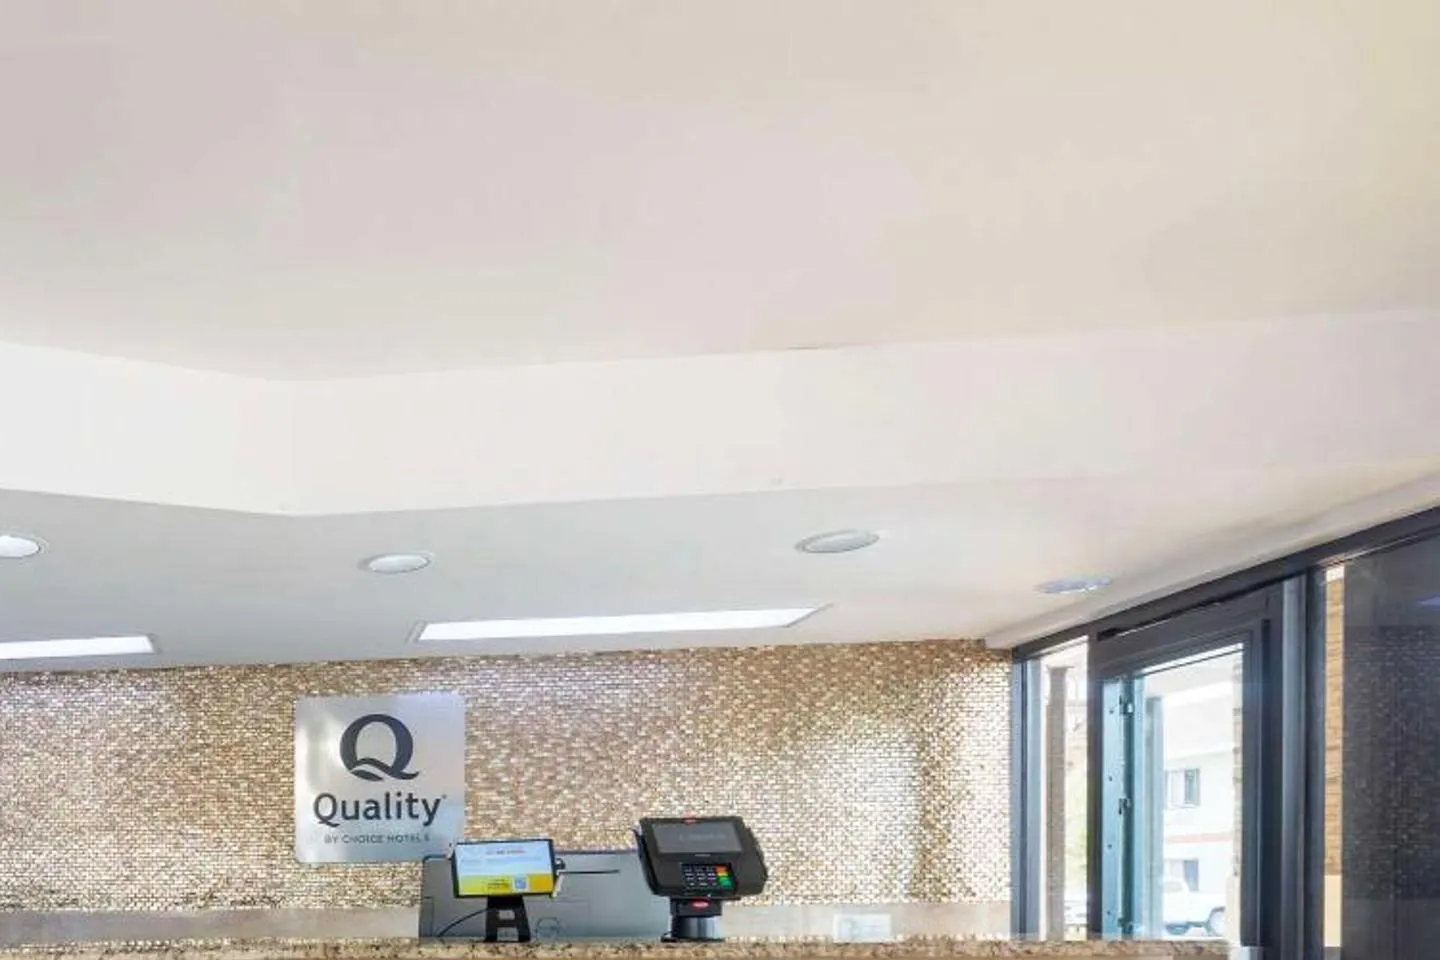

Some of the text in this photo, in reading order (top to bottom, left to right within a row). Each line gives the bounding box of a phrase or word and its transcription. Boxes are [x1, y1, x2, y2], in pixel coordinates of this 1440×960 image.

[340, 713, 420, 782] Q
[313, 791, 443, 828] Quality
[341, 833, 383, 844] CHOICE
